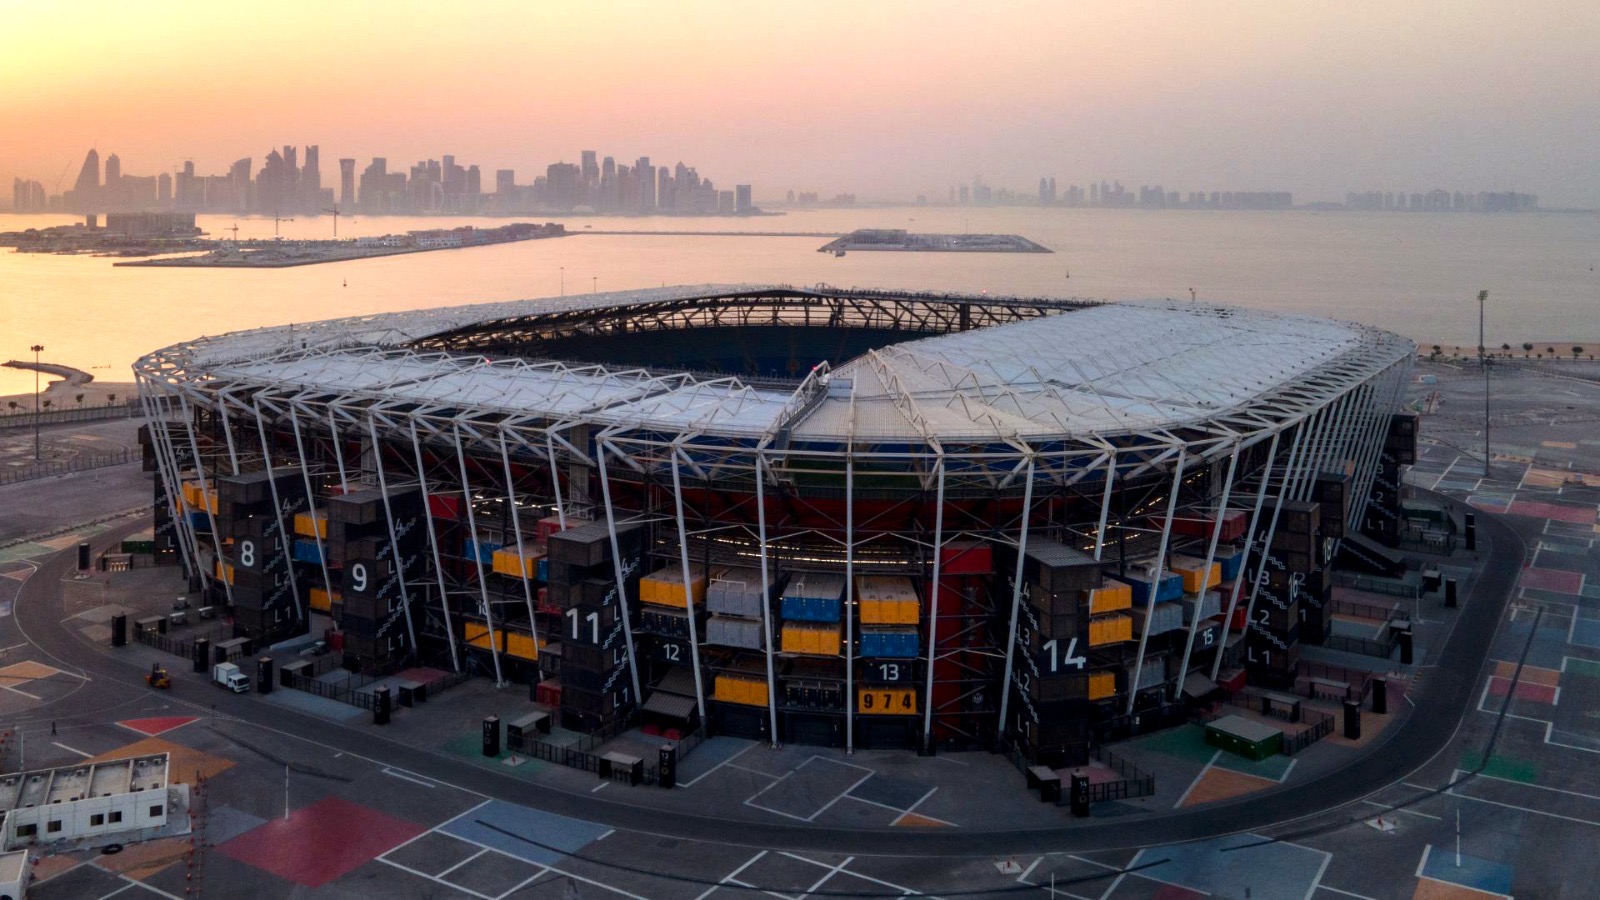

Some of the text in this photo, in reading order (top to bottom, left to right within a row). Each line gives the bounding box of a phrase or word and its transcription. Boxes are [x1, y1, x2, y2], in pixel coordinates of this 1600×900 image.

[1367, 518, 1384, 531] L1
[241, 540, 254, 567] 8
[1322, 536, 1332, 565] 18
[275, 570, 291, 587] L2
[352, 563, 367, 592] 9
[1249, 568, 1271, 586] L3
[1288, 572, 1299, 603] 16
[388, 595, 405, 613] L2
[275, 606, 290, 623] L1
[566, 607, 599, 645] 11
[388, 634, 403, 651] L1
[1203, 628, 1213, 646] 15
[613, 645, 629, 664] L2
[662, 643, 680, 661] 12
[1042, 637, 1087, 673] 14
[1248, 646, 1271, 665] L1
[879, 663, 900, 681] 13
[613, 687, 628, 707] L1
[1017, 713, 1030, 738] L1
